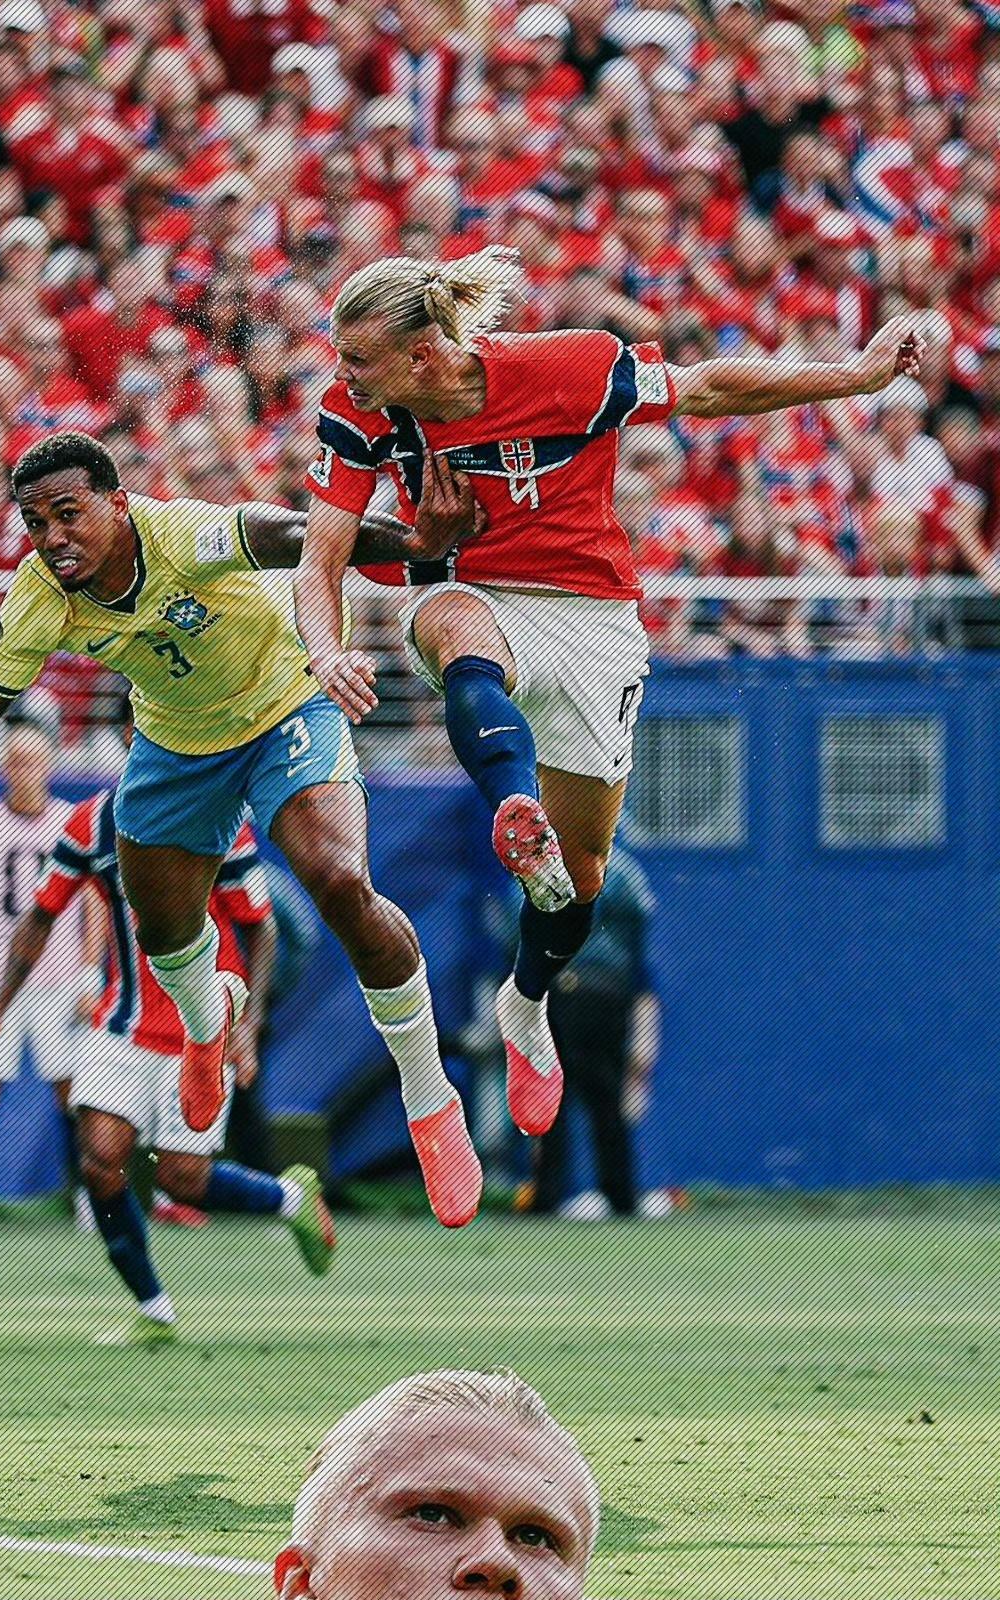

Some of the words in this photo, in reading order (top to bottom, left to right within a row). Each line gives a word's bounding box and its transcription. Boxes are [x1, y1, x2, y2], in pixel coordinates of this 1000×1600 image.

[187, 611, 223, 639] BRASIL
[152, 641, 195, 679] 3
[280, 715, 312, 760] 3
